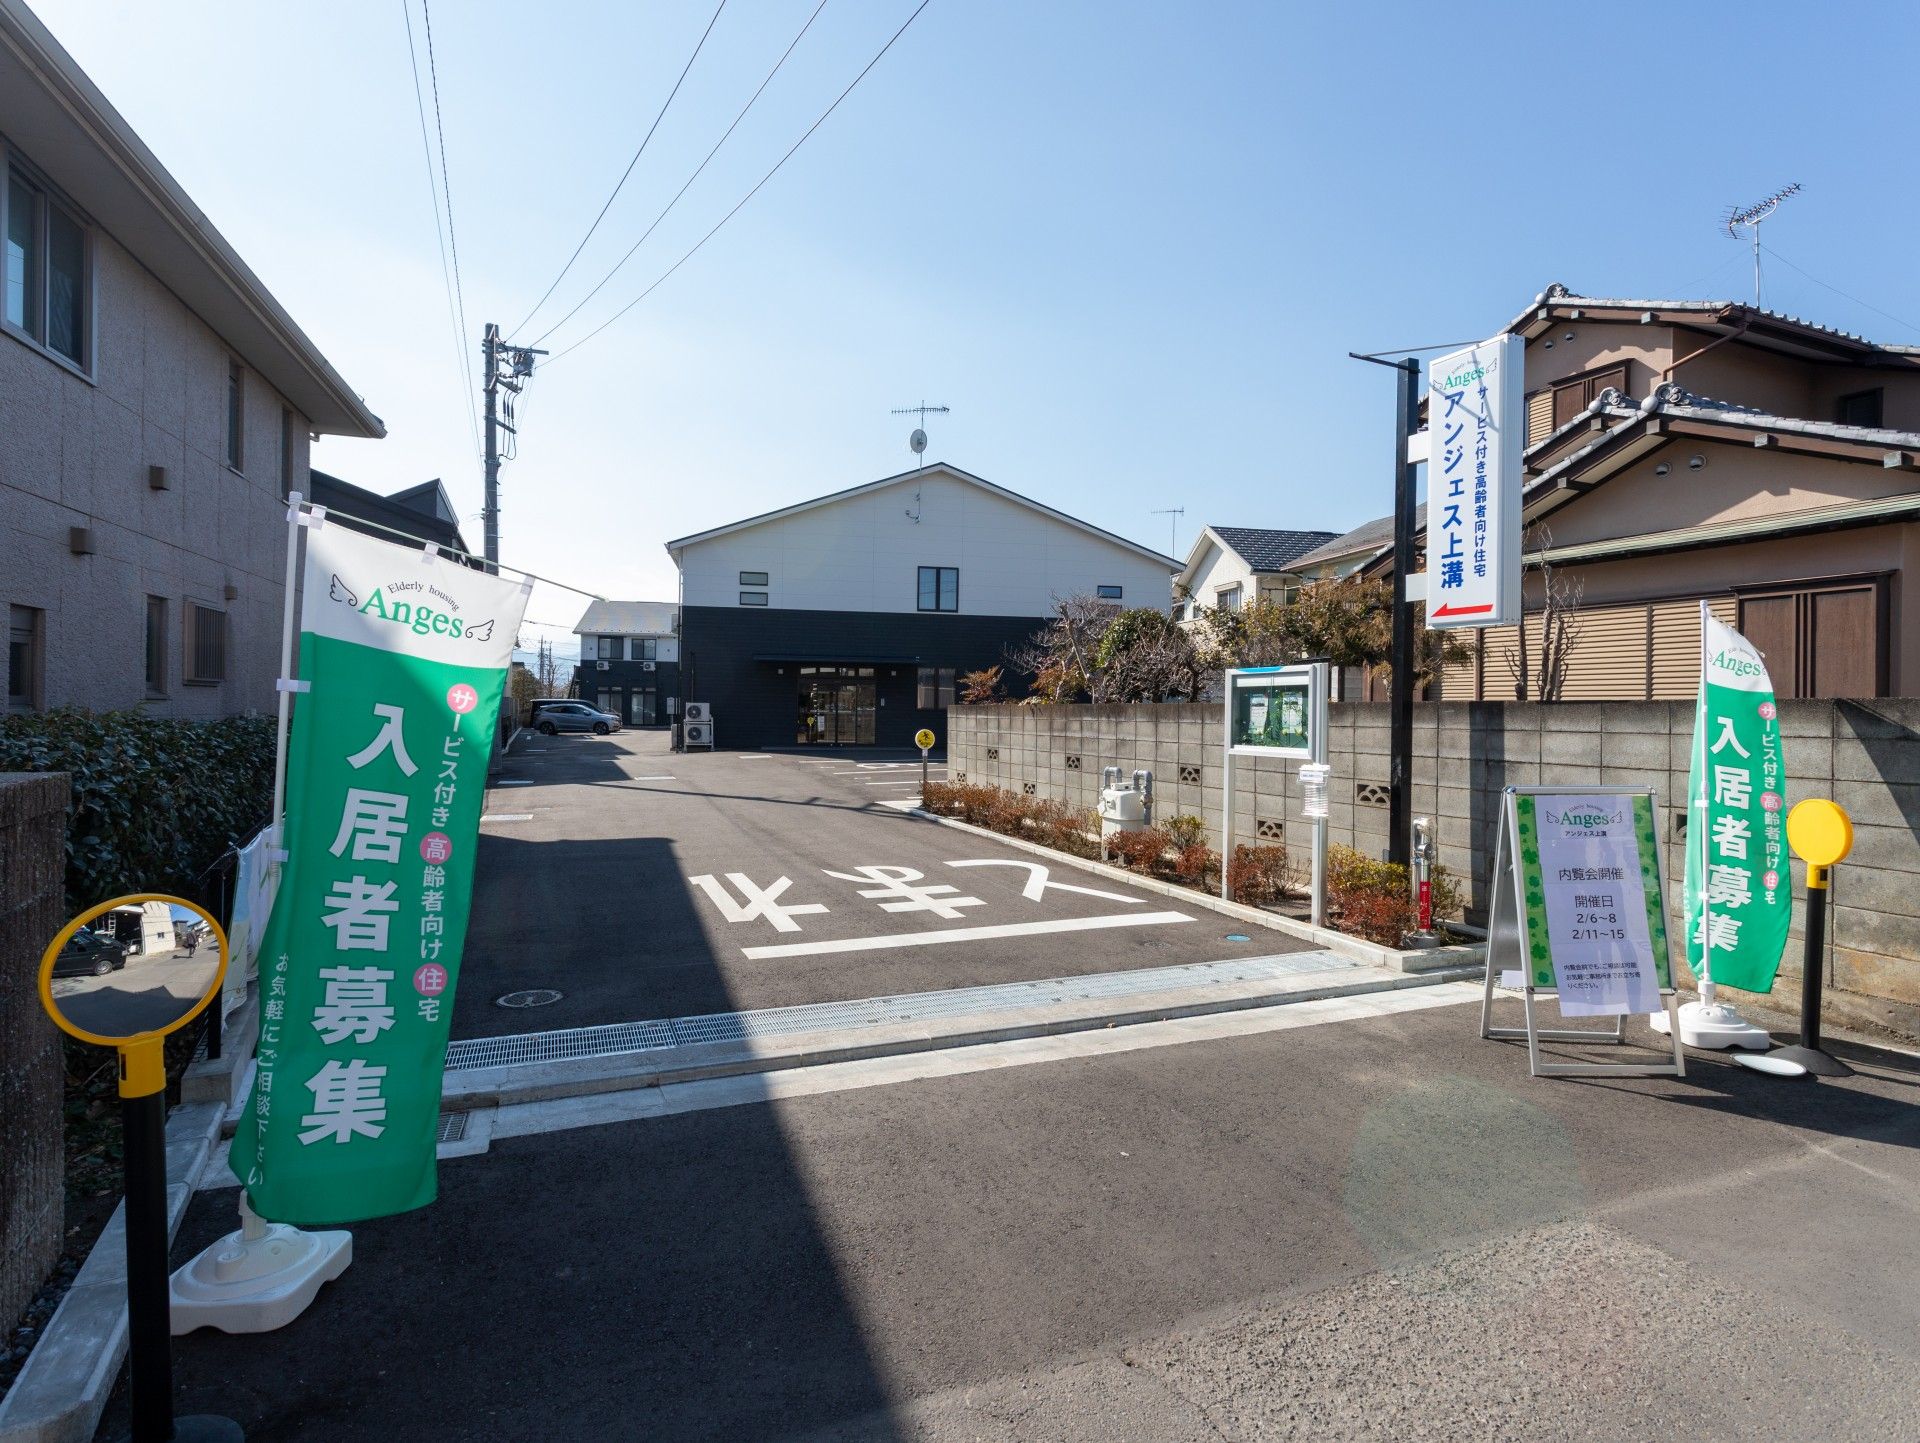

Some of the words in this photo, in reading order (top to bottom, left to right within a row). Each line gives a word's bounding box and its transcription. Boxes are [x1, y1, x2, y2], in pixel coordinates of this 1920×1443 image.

[1443, 367, 1485, 390] Anges
[1440, 390, 1465, 589] アンジェス上溝
[1473, 385, 1489, 578] サービス付き高齢者向け住宅
[358, 587, 464, 639] Anges
[387, 581, 424, 594] Elderly
[429, 585, 460, 613] housing
[1712, 650, 1761, 676] Anges
[1560, 811, 1610, 829] Anges
[1760, 704, 1781, 905] サービス付き高齢者向け住宅
[418, 688, 475, 1023] サービス付き高齢者向け住宅
[1693, 716, 1752, 952] 入居者募集
[1558, 867, 1625, 881] 内覧会開催
[297, 702, 419, 1146] 入居者募集
[1574, 895, 1614, 908] 開催日
